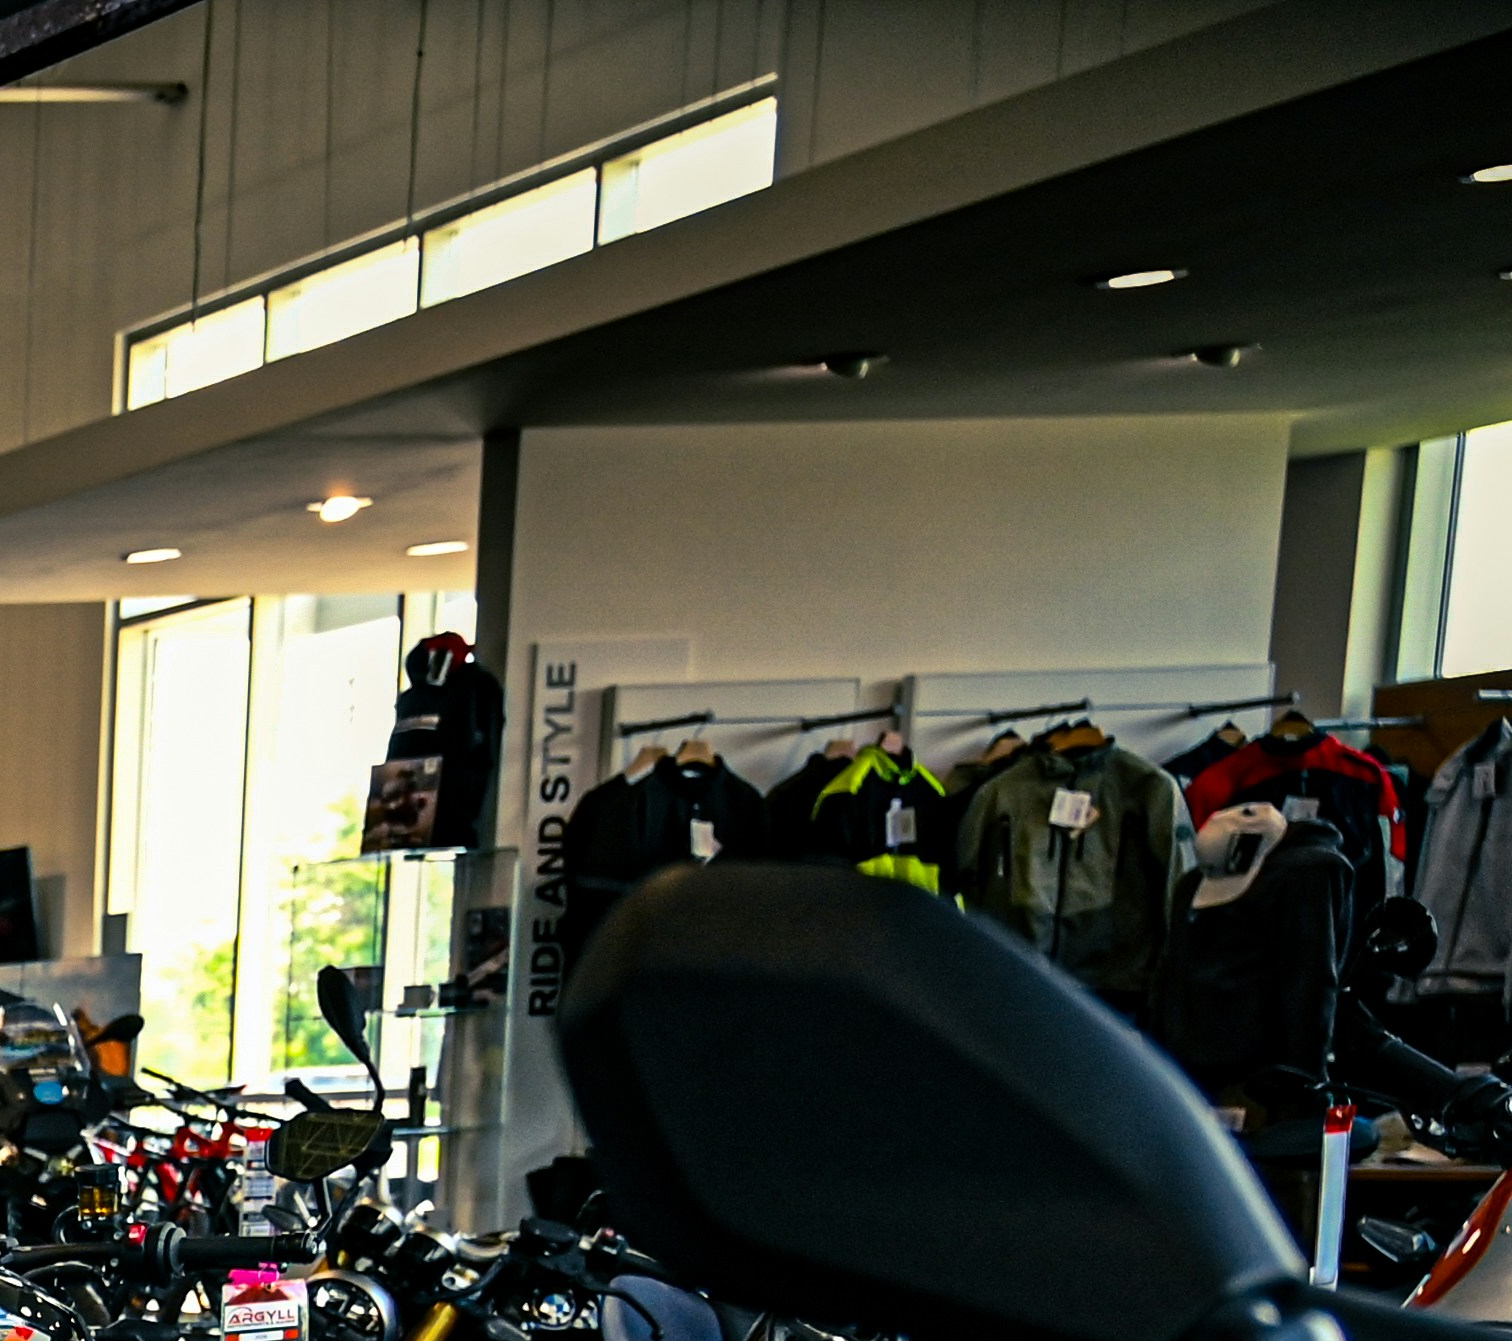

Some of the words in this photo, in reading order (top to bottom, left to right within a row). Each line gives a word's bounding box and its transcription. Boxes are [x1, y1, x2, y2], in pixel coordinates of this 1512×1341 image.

[541, 661, 578, 803] STYLE
[535, 812, 569, 903] AND
[228, 1308, 295, 1325] ARGYLL
